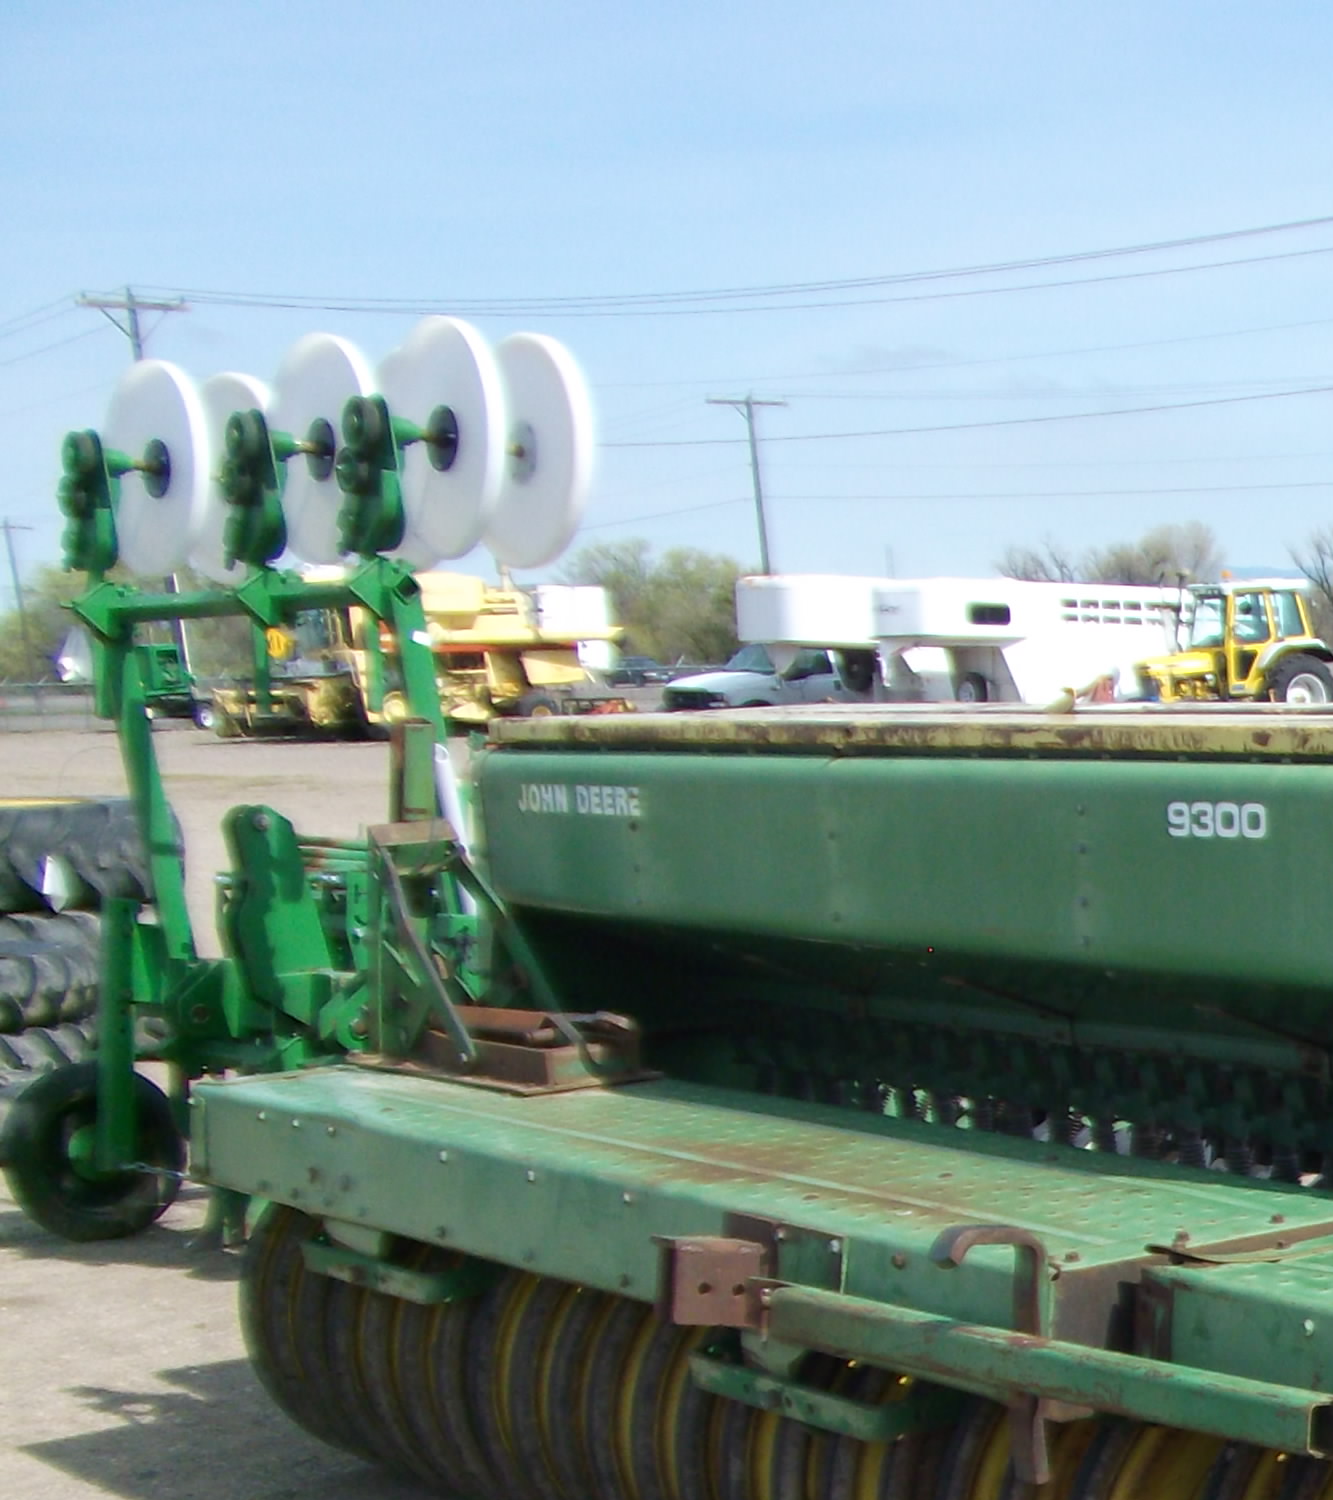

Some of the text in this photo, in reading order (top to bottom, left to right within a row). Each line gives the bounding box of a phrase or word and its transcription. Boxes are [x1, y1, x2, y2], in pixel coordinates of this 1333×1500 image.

[518, 784, 641, 816] JOHN DEERE
[1167, 801, 1266, 839] 9300
